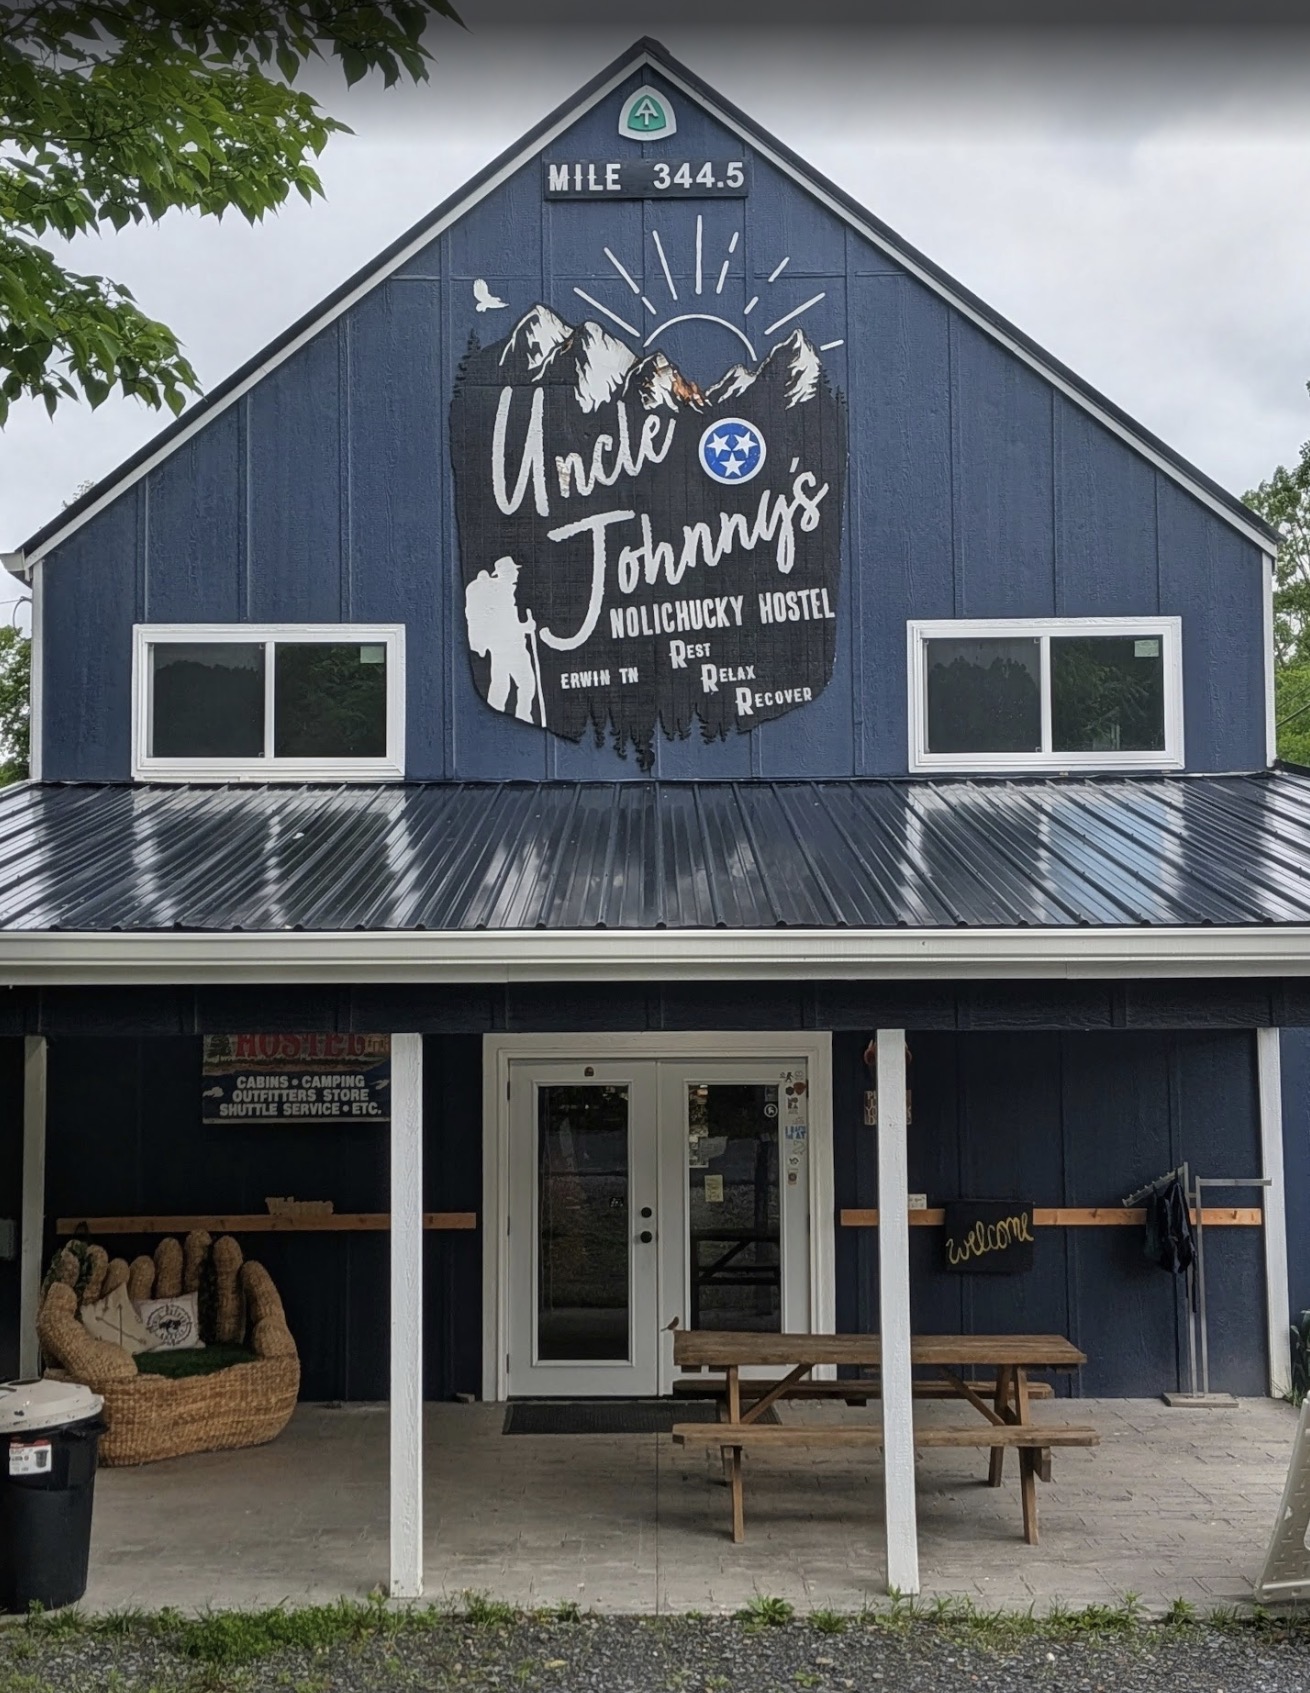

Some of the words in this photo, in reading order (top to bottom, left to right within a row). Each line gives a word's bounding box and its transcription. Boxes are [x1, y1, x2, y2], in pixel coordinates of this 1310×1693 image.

[547, 163, 622, 192] MILE
[652, 161, 745, 190] 344.5
[491, 385, 677, 517] Uncle
[538, 456, 830, 652] Johnny's
[609, 595, 744, 639] NOLICHUCKY
[759, 588, 836, 625] HOSTEL
[560, 670, 611, 690] ERWIN
[619, 668, 639, 684] TN
[232, 1089, 317, 1103] OUTFITTERS
[322, 1088, 369, 1101] STORE
[236, 1076, 289, 1089] CABINS
[301, 1075, 366, 1089] CAMPING
[219, 1103, 278, 1117] SHUTTLE
[282, 1102, 340, 1116] SERVICE
[351, 1102, 382, 1115] ETC.
[945, 1211, 1035, 1265] welcome
